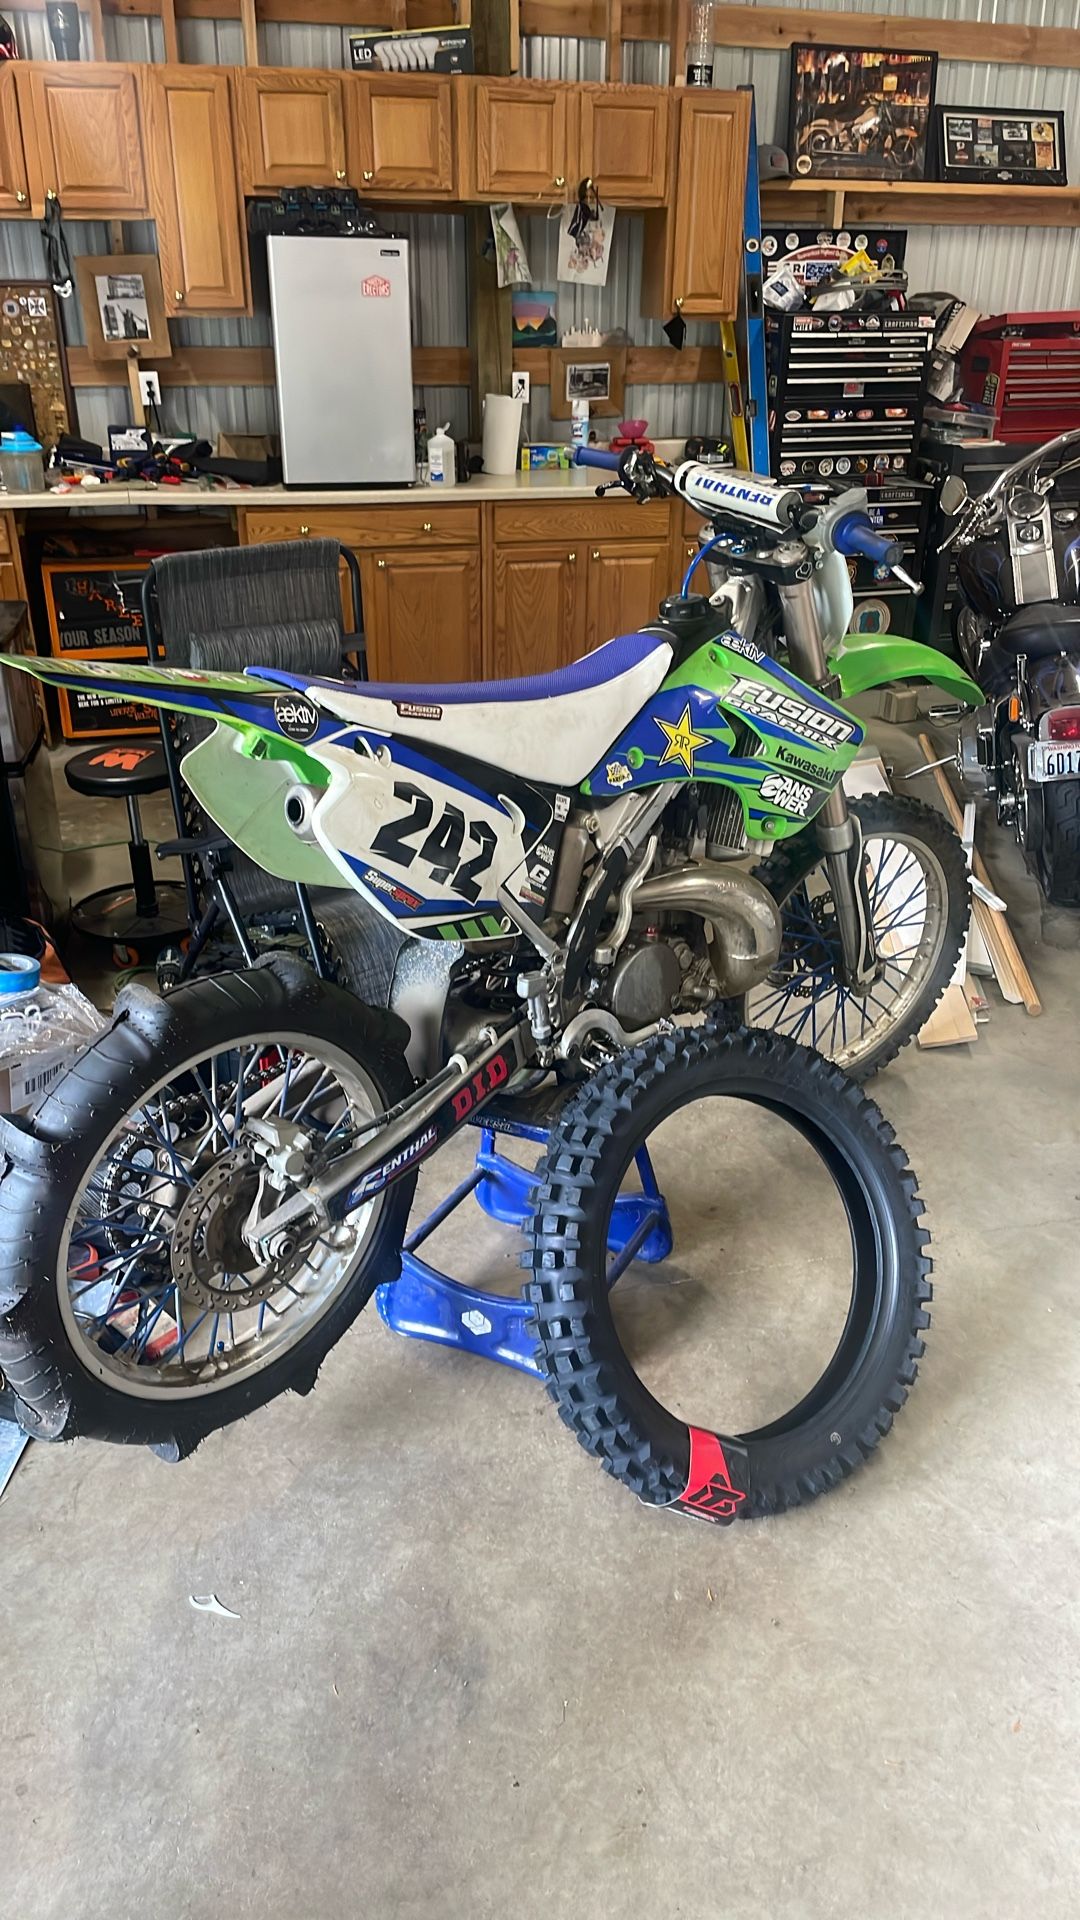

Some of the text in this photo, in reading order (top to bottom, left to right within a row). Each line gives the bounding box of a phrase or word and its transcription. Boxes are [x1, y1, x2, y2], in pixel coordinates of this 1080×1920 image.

[353, 48, 372, 60] LED
[94, 626, 141, 644] SEASON
[722, 697, 838, 752] GRAPHIX
[775, 745, 835, 782] Kawasaki
[779, 775, 814, 800] ANS
[773, 791, 809, 817] WER
[369, 781, 498, 907] 242
